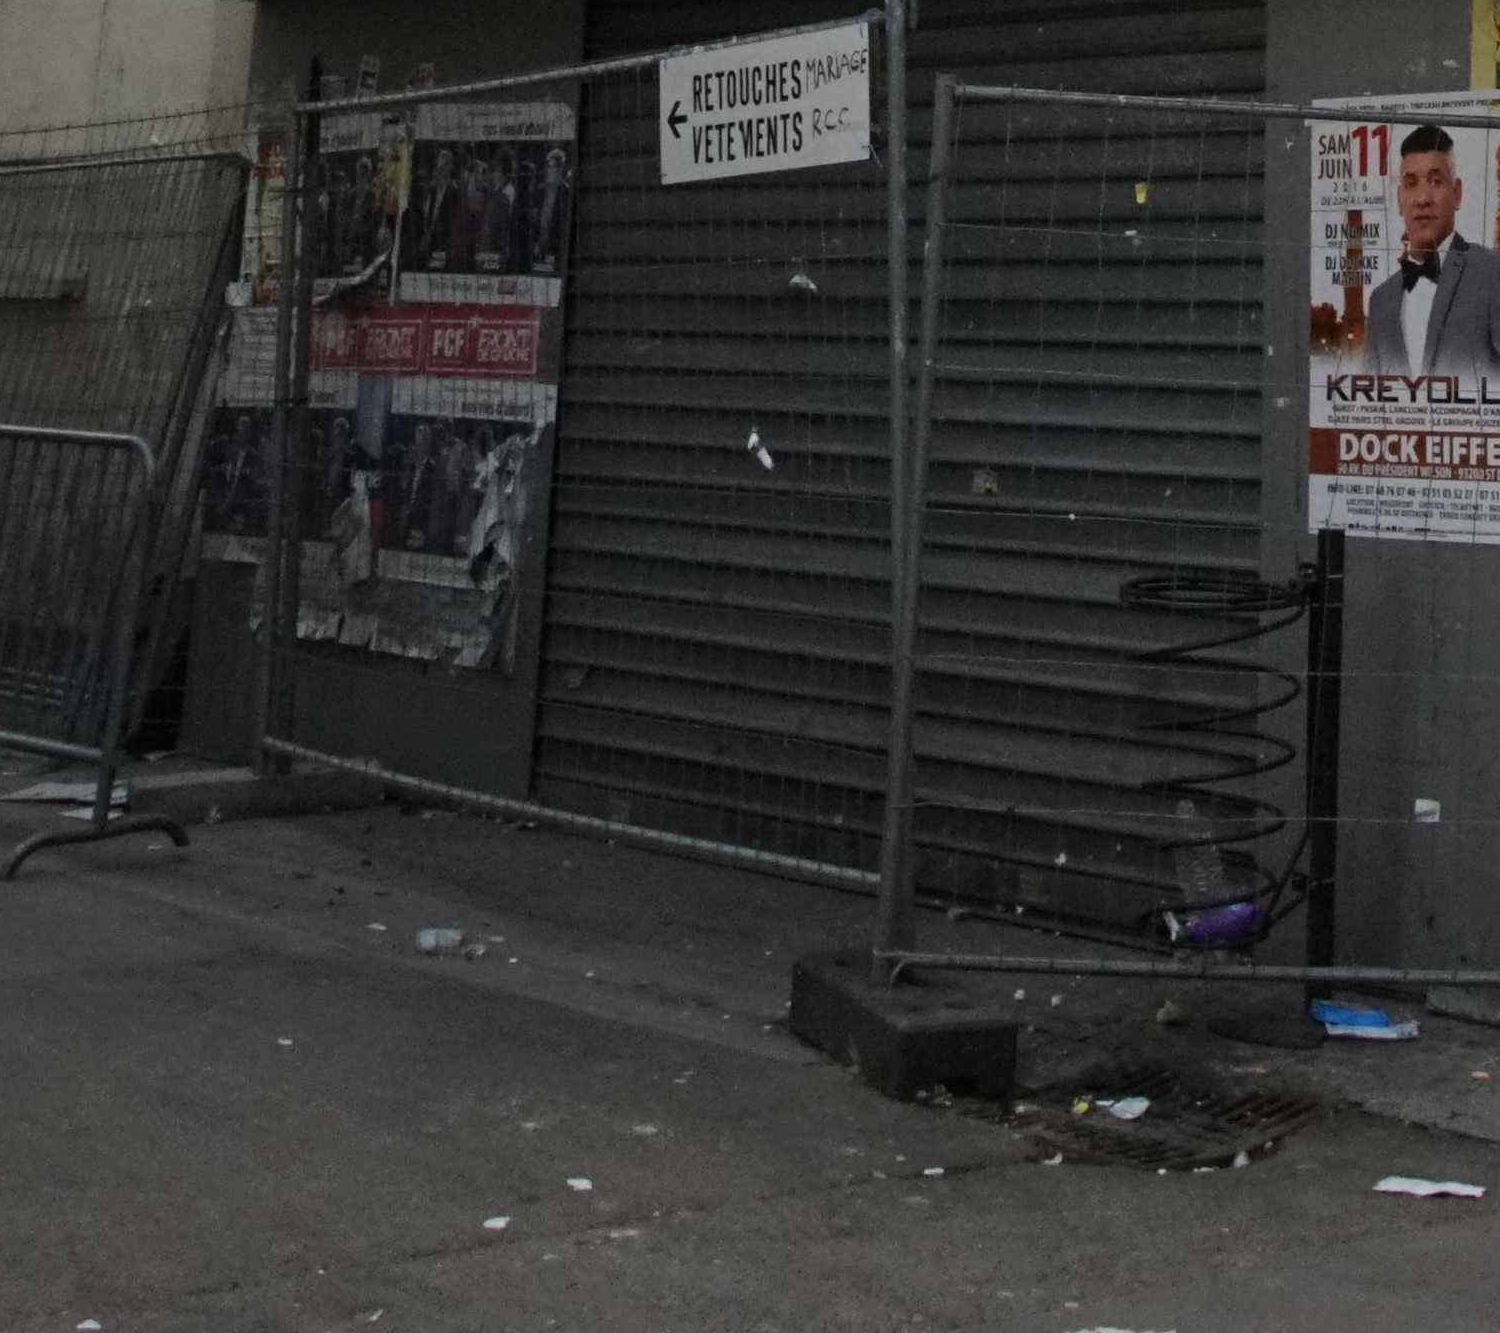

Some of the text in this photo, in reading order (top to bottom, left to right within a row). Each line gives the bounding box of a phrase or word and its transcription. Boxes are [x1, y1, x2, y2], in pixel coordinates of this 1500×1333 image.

[692, 59, 802, 113] RETOUCHES
[805, 48, 868, 94] MARIAGE
[692, 111, 803, 164] VETEMENTS
[1318, 134, 1350, 155] SAM
[1352, 124, 1388, 177] 11
[1318, 158, 1353, 179] JUIN
[1325, 224, 1336, 239] DJ
[1325, 256, 1336, 271] DJ
[431, 328, 466, 358] PCF
[1339, 433, 1419, 463] DOCK
